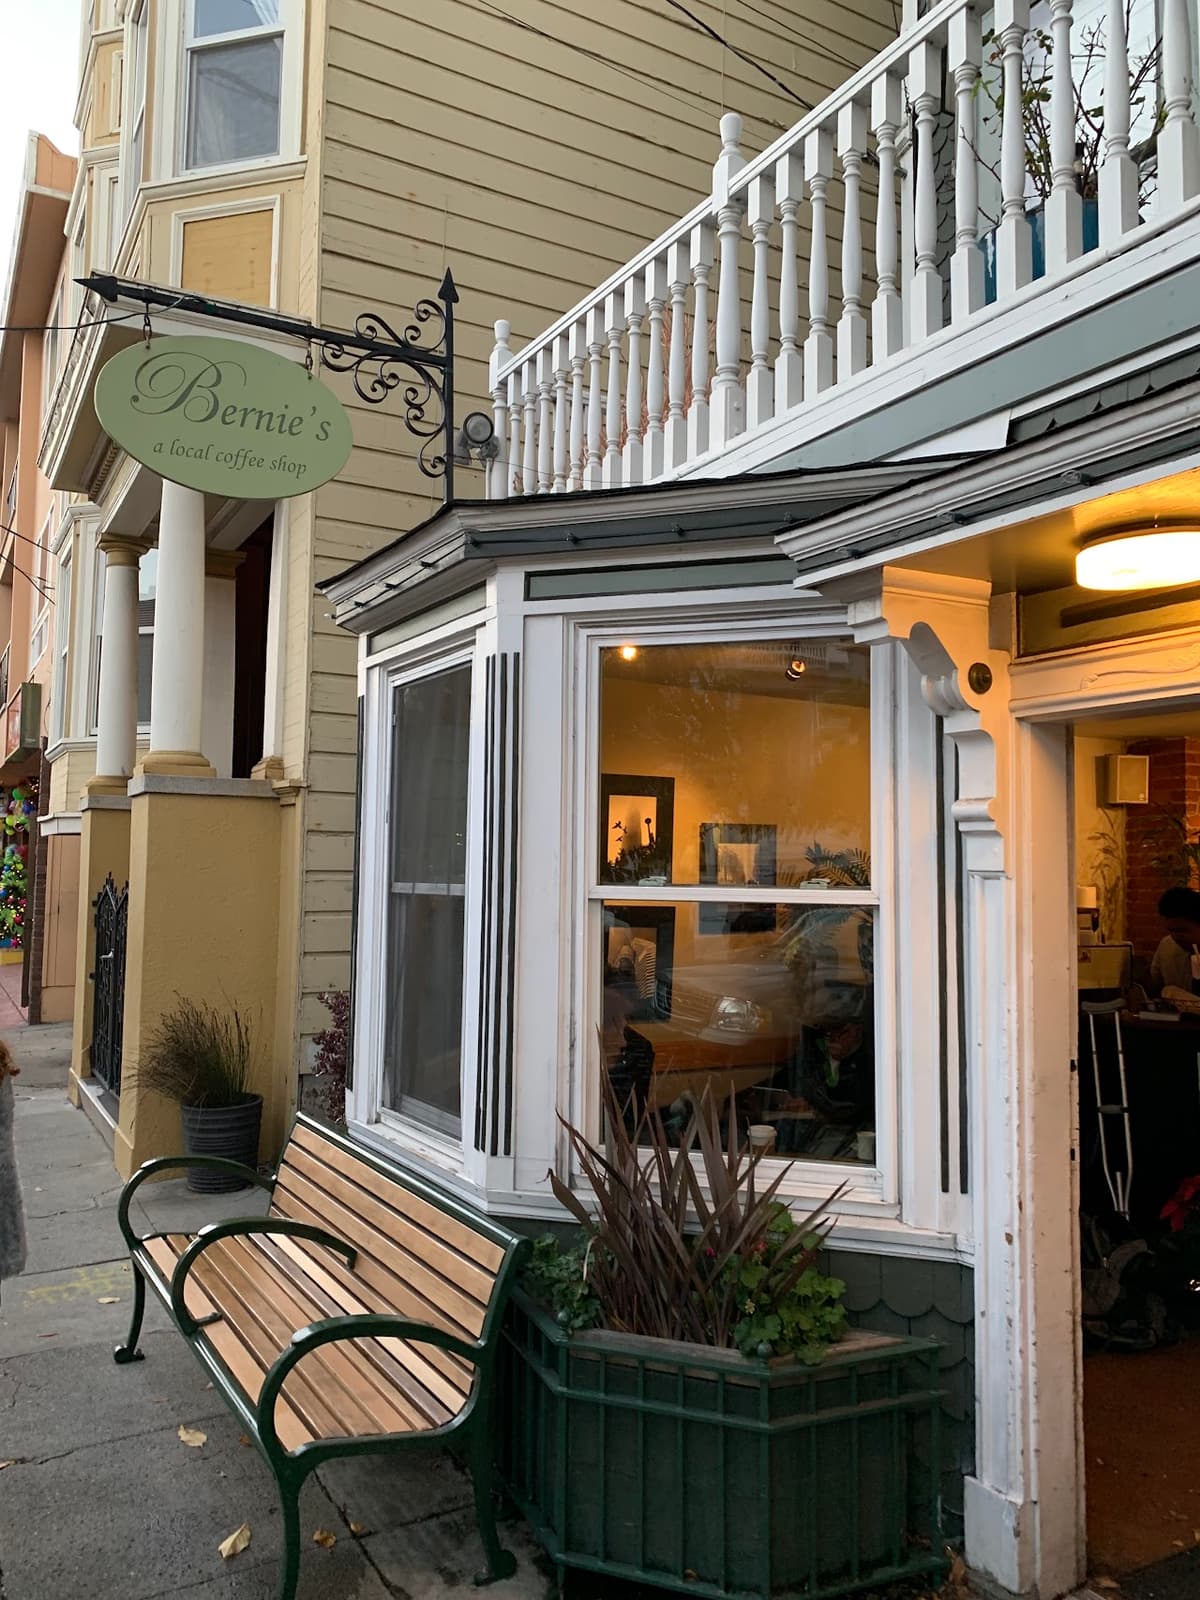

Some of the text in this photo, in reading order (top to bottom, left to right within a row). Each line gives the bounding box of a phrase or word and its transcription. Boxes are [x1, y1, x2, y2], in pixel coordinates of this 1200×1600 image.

[130, 352, 332, 441] Bernie's
[153, 438, 307, 479] a local coffee shop
